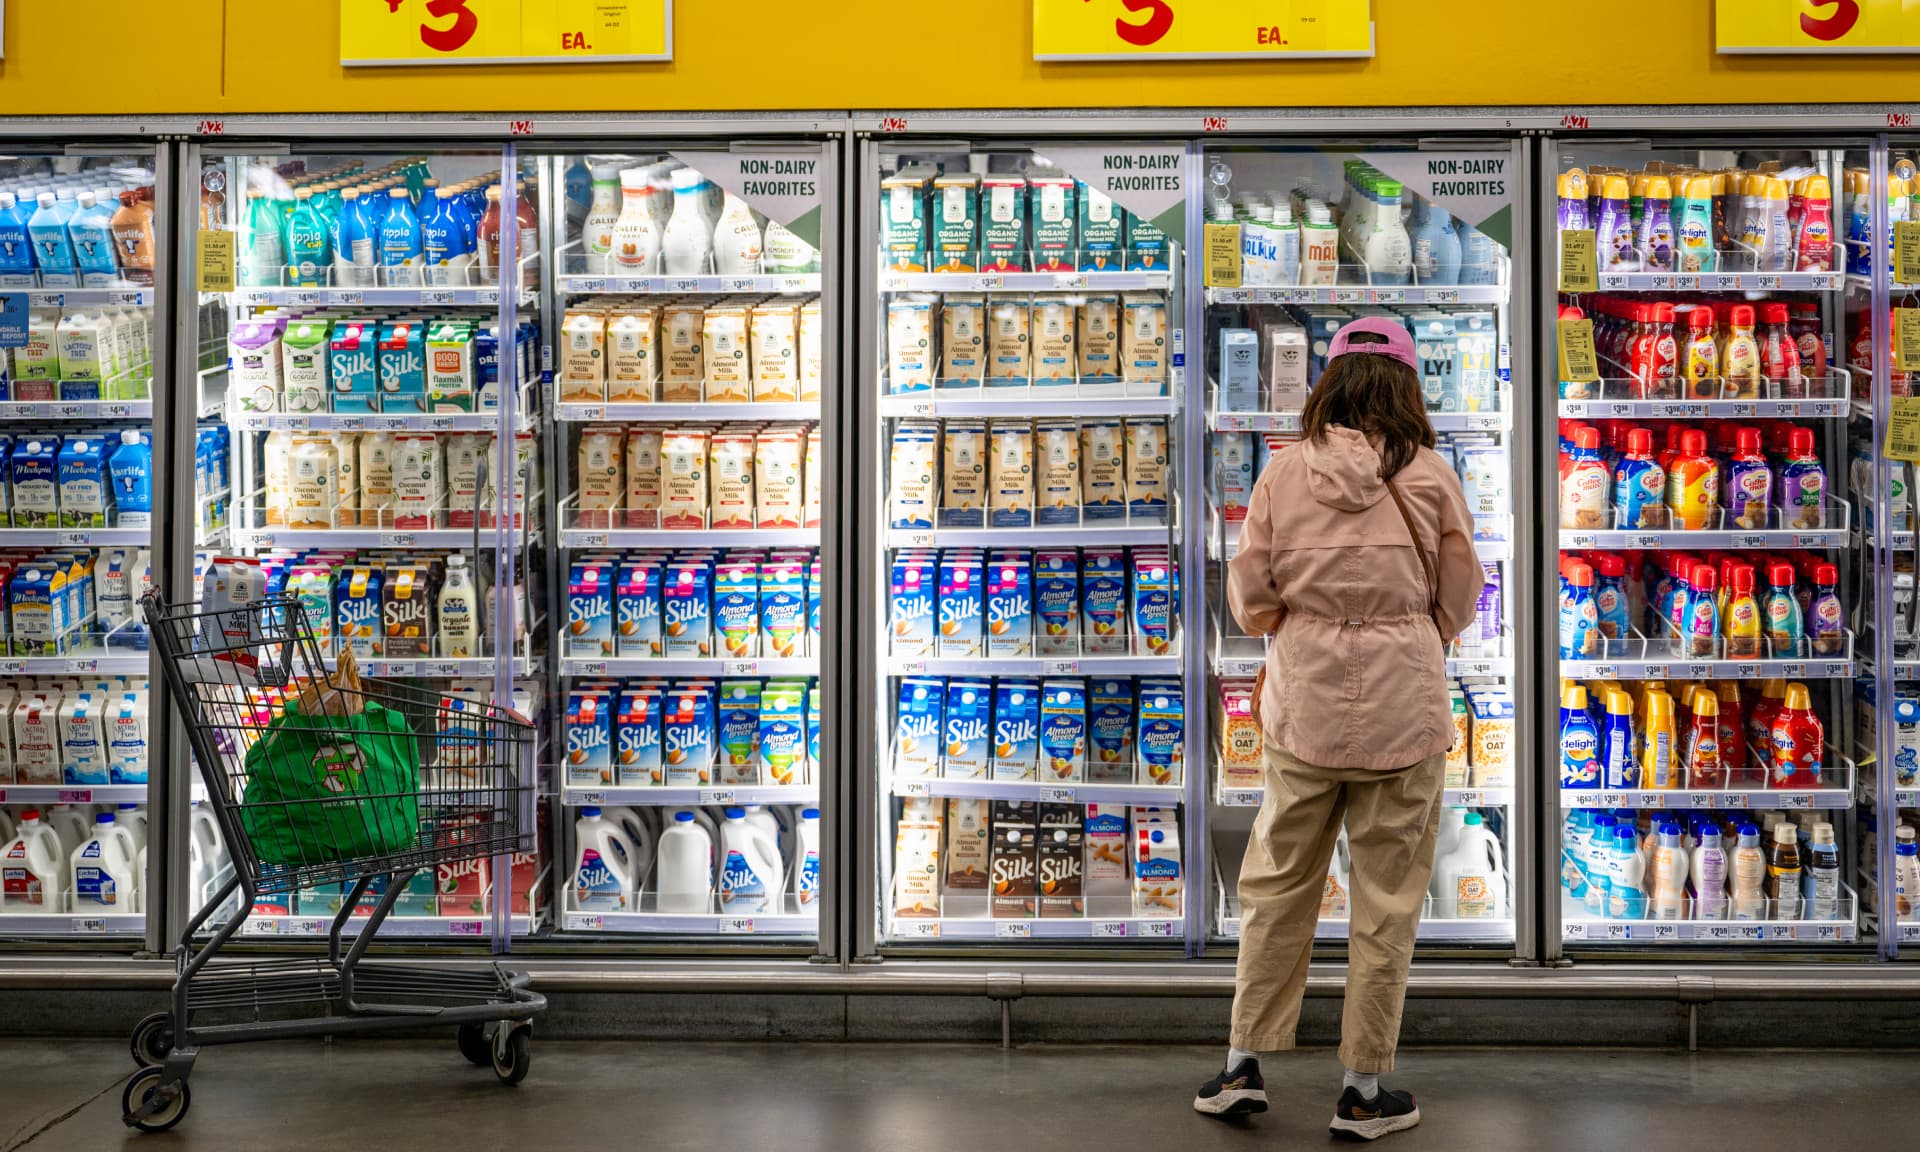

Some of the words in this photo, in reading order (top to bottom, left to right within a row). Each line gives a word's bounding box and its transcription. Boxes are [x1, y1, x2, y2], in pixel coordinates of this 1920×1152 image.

[384, 0, 478, 52] 3
[1083, 0, 1174, 46] 3
[562, 32, 592, 50] EA.
[1257, 26, 1288, 45] EA.
[201, 121, 223, 134] A23
[511, 121, 533, 134] A24
[883, 118, 907, 131] A25
[1203, 117, 1227, 131] A26
[1565, 116, 1588, 128] A27
[1887, 114, 1911, 127] A28
[740, 160, 815, 175] NON-DAIRY
[1104, 155, 1180, 169] NON-DAIRY
[1428, 160, 1504, 175] NON-DAIRY
[743, 181, 815, 196] FAVORITES
[1107, 176, 1180, 190] FAVORITES
[1432, 181, 1504, 196] FAVORITES
[939, 230, 971, 239] ORGANIC
[986, 230, 1019, 238] ORGANIC
[1037, 230, 1070, 238] ORGANIC
[1084, 230, 1116, 238] ORGANIC
[1309, 245, 1336, 260] MAL
[437, 353, 458, 361] GOOD
[1133, 347, 1158, 355] Almond
[1418, 343, 1455, 360] OAT
[333, 352, 374, 378] Silk
[380, 351, 423, 378] Silk
[568, 359, 595, 367] Almond
[615, 360, 641, 368] Almond
[1425, 361, 1452, 375] LY!
[433, 375, 463, 384] flaxmilk
[1743, 478, 1768, 486] Coffee
[1040, 588, 1074, 601] Almond
[1088, 588, 1122, 601] Almond
[338, 601, 380, 625] Silk
[384, 599, 427, 625] Silk
[570, 596, 610, 625] Silk
[618, 596, 660, 625] Silk
[666, 598, 709, 625] Silk
[718, 602, 754, 617] Almond
[764, 604, 800, 617] Almond
[893, 595, 933, 622] Silk
[940, 597, 981, 624] Silk
[989, 595, 1031, 623] Silk
[442, 616, 471, 624] Organic
[900, 714, 939, 738] Silk
[1095, 715, 1130, 727] Almond
[722, 722, 757, 735] Almond
[947, 718, 988, 745] Silk
[995, 719, 1038, 745] Silk
[1045, 724, 1082, 737] Almond
[568, 725, 608, 752] Silk
[619, 725, 660, 752] Silk
[666, 725, 707, 752] Silk
[763, 731, 799, 744] Almond
[1143, 730, 1180, 743] Almond
[1235, 739, 1254, 748] OAT
[1486, 741, 1505, 751] OAT
[1561, 738, 1597, 750] delight
[1090, 824, 1122, 833] ALMOND
[438, 858, 480, 882] Silk
[992, 857, 1034, 885] Silk
[1040, 857, 1082, 885] Silk
[1141, 868, 1176, 877] ALMOND
[578, 868, 614, 890] Silk
[722, 870, 755, 891] Silk
